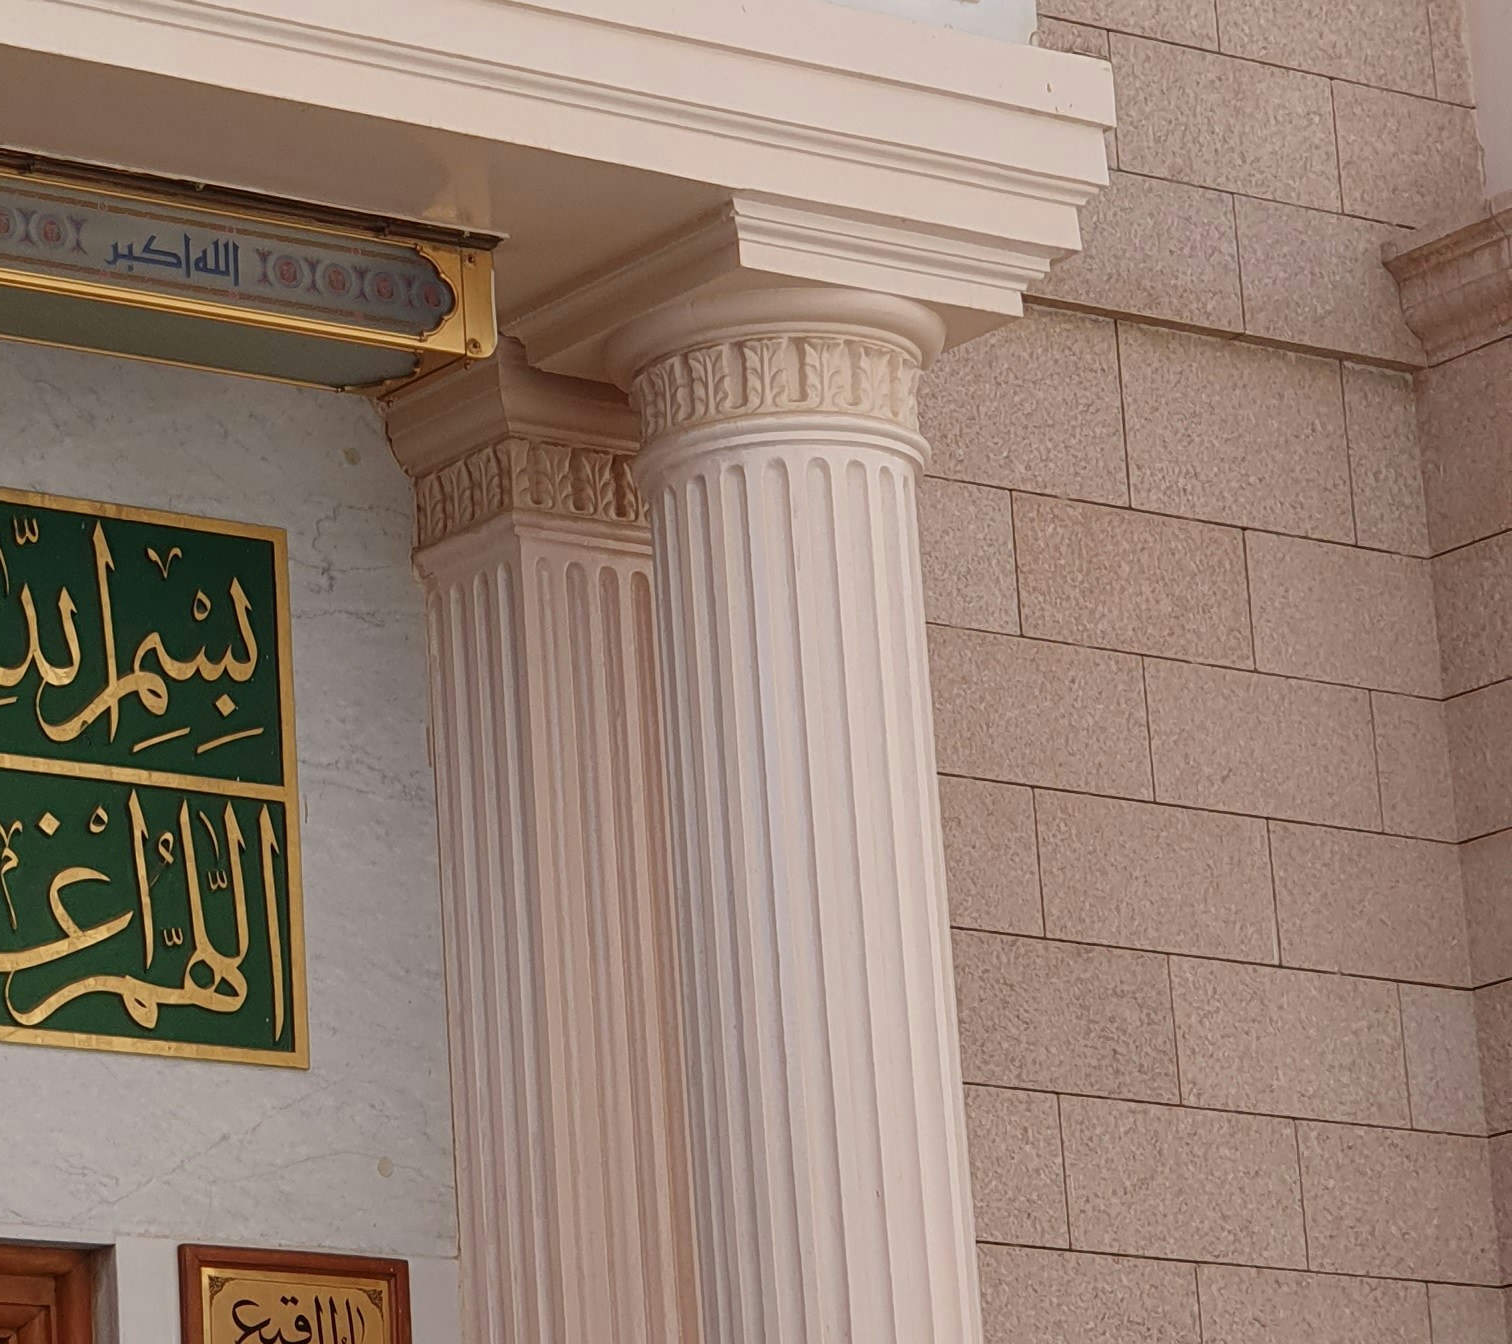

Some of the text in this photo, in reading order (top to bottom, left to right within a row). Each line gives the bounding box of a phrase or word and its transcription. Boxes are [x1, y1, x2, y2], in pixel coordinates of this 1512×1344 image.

[194, 237, 240, 287] الله
[36, 576, 260, 743] بسم
[6, 788, 284, 1043] اللهم
